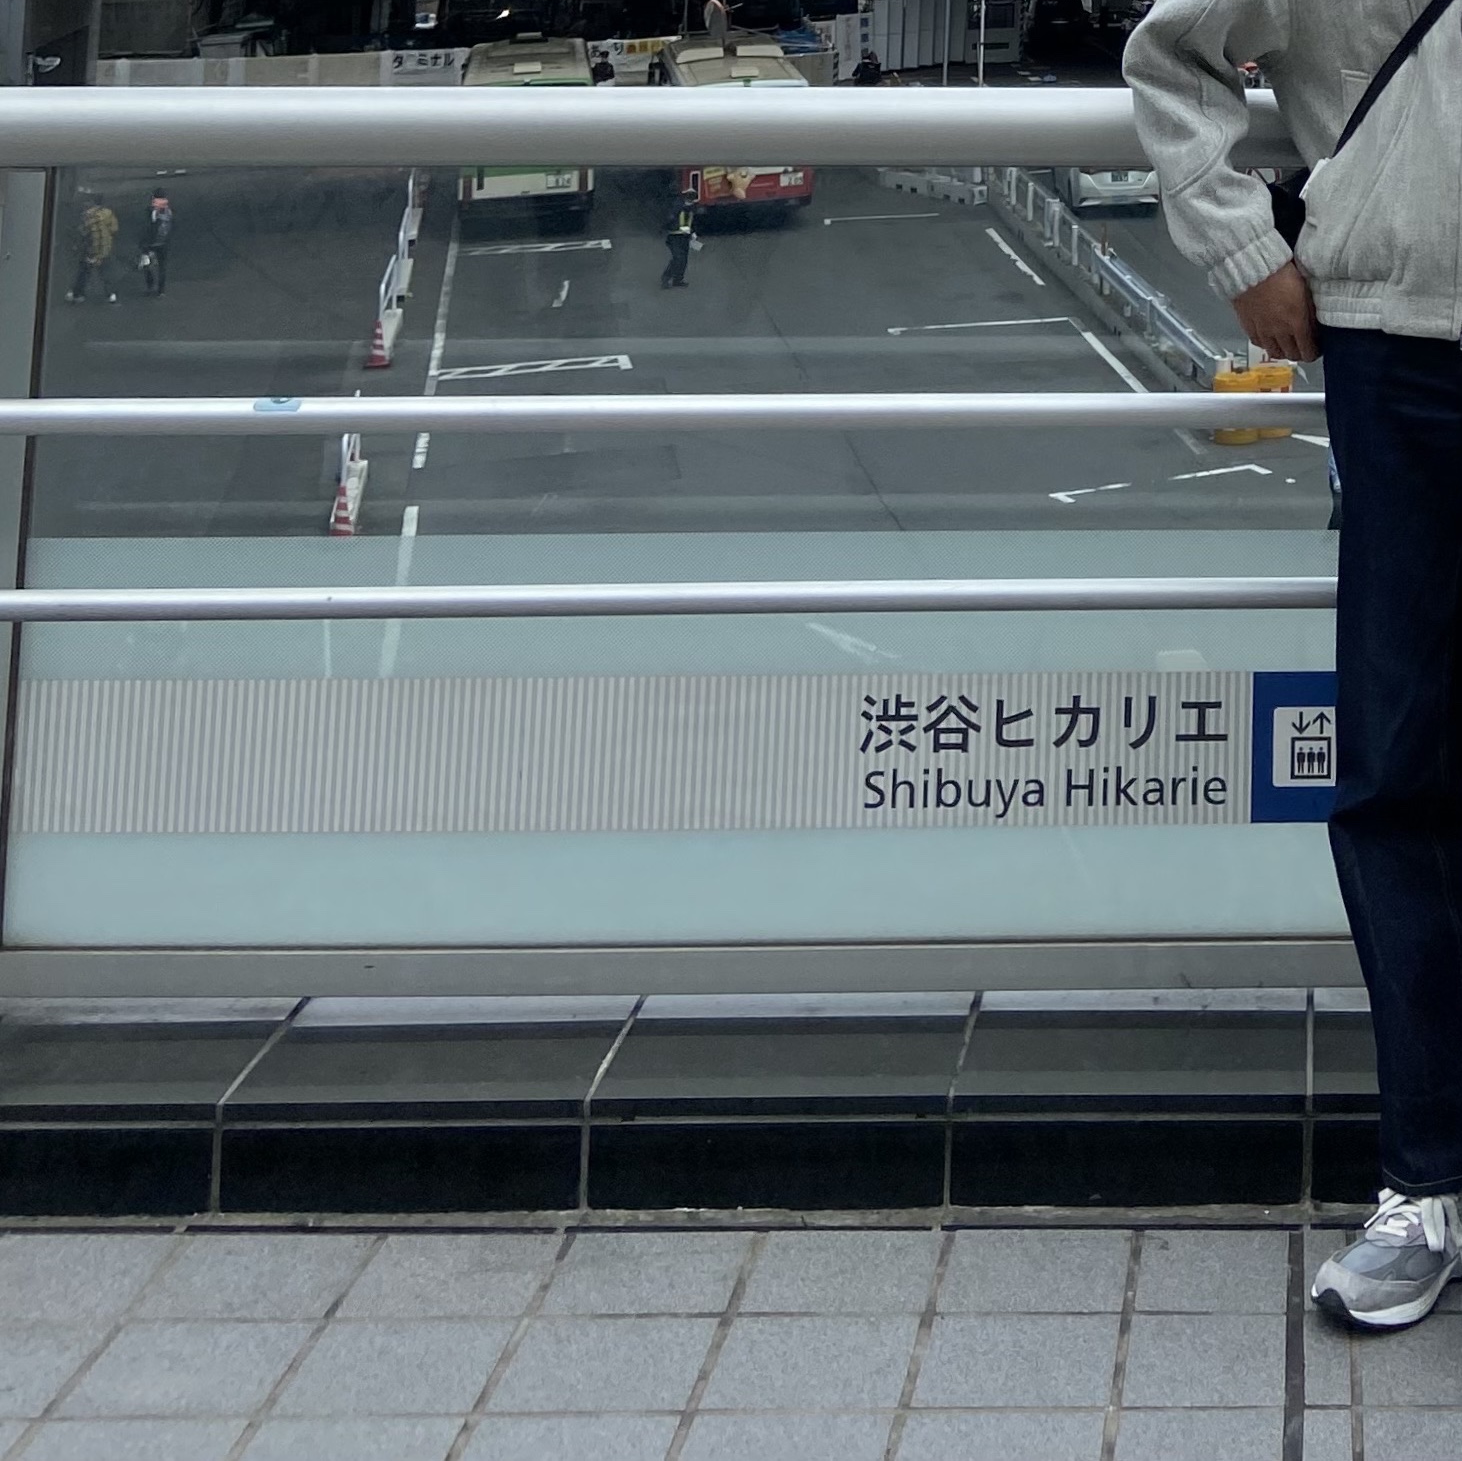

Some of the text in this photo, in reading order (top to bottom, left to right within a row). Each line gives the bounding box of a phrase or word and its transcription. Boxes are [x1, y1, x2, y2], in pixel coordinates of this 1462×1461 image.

[859, 694, 1229, 754] 渋谷ヒカリエ
[863, 766, 1229, 818] Shibuya Hikarie
